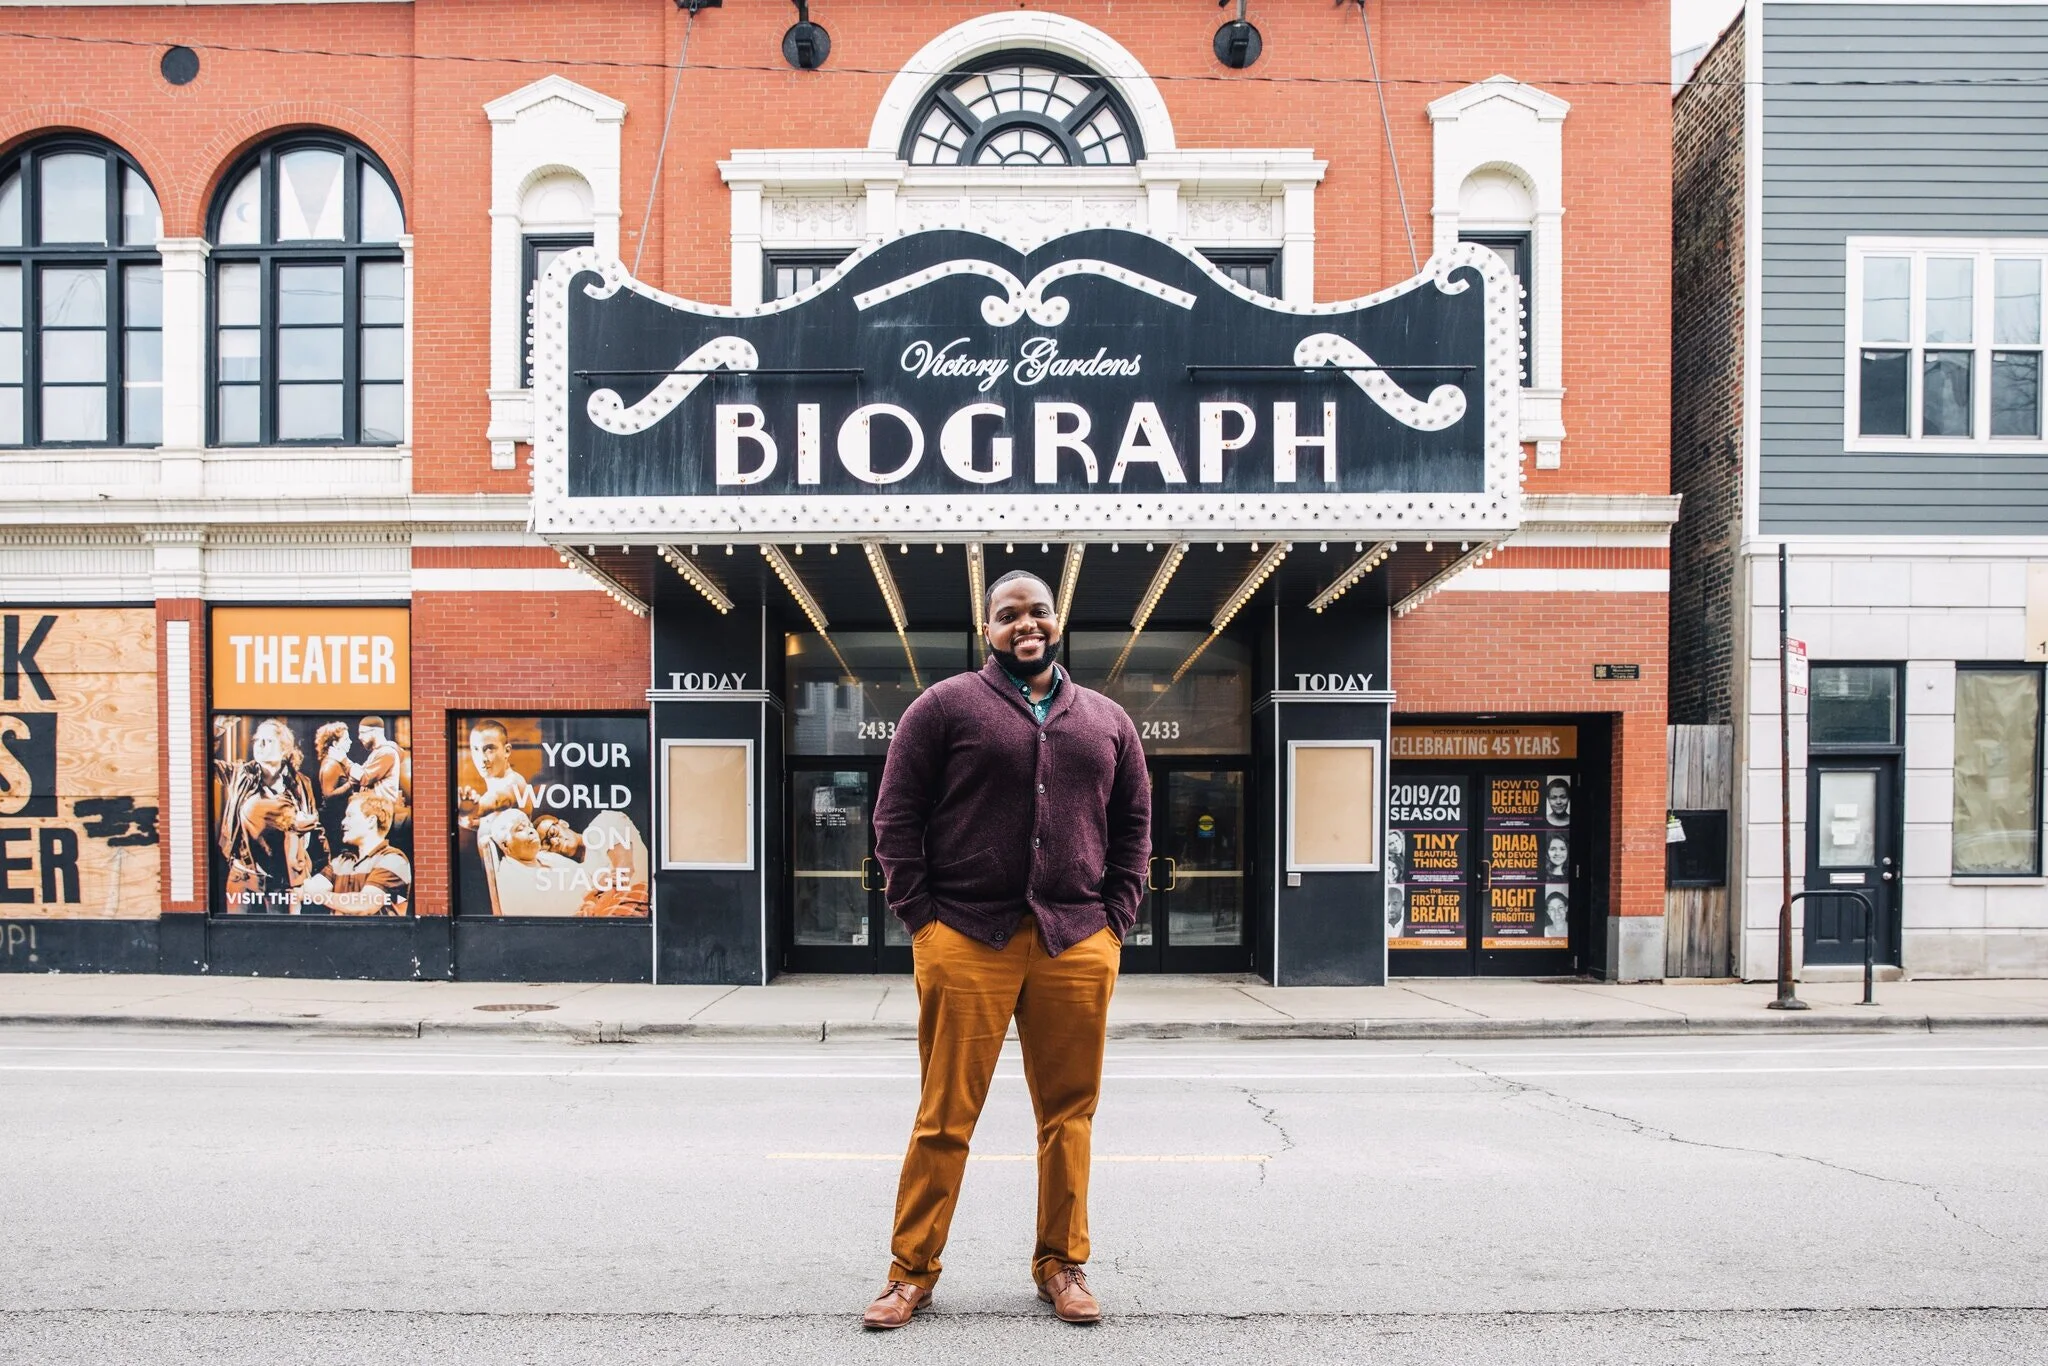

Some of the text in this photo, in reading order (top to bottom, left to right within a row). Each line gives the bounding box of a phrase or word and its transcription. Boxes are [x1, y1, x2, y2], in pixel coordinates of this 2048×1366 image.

[900, 336, 1142, 392] Victory Gardens
[715, 401, 1336, 486] BIOGRAPH
[229, 634, 396, 685] THEATER
[668, 672, 748, 691] TODAY
[1294, 673, 1374, 691] TODAY
[857, 721, 896, 740] 2433
[1141, 721, 1181, 740] 2433
[541, 742, 631, 768] YOUR
[1391, 736, 1560, 756] CELEBRATING 45 YEARS
[1492, 780, 1540, 790] HOW TO
[511, 783, 632, 809] WORLD
[1390, 785, 1461, 806] 2019/20
[1492, 790, 1540, 806] DEFEND
[1390, 807, 1460, 821] SEASON
[1492, 806, 1539, 814] YOURSELF
[581, 825, 632, 851] ON
[1412, 833, 1460, 850] TINY
[1492, 834, 1538, 852] DHABA
[1413, 850, 1458, 858] BEAUTIFUL
[1492, 851, 1538, 859] ON DEVON
[1413, 858, 1458, 869] THINGS
[1491, 859, 1538, 869] AVENUE
[535, 866, 632, 892] STAGE
[226, 892, 392, 906] VISIT THE BOX OFFICE
[1411, 894, 1460, 906] FIRST DEEP
[1491, 888, 1537, 908] RIGHT
[1411, 906, 1460, 923] BREATH
[1491, 912, 1536, 922] FORGOTTEN
[0, 923, 38, 962] P!
